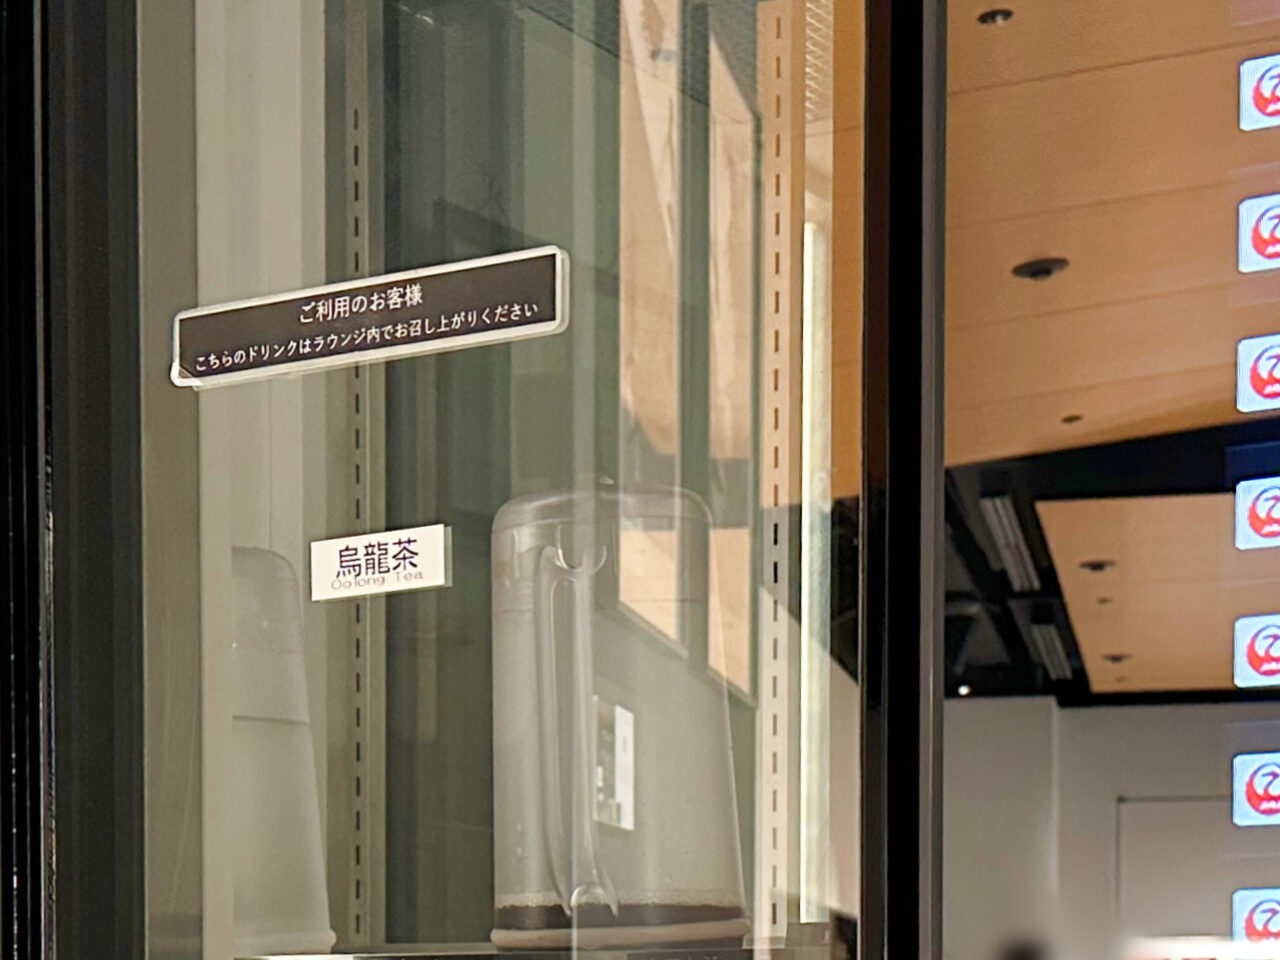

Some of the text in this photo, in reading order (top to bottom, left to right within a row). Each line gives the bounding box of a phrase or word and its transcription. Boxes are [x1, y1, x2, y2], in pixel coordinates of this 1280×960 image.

[299, 284, 423, 324] ご利用のお客様
[195, 302, 539, 372] こちらのドリンクはラウンジ内でお召し上がりください
[336, 536, 419, 579] 烏龍茶
[396, 571, 424, 582] Tea
